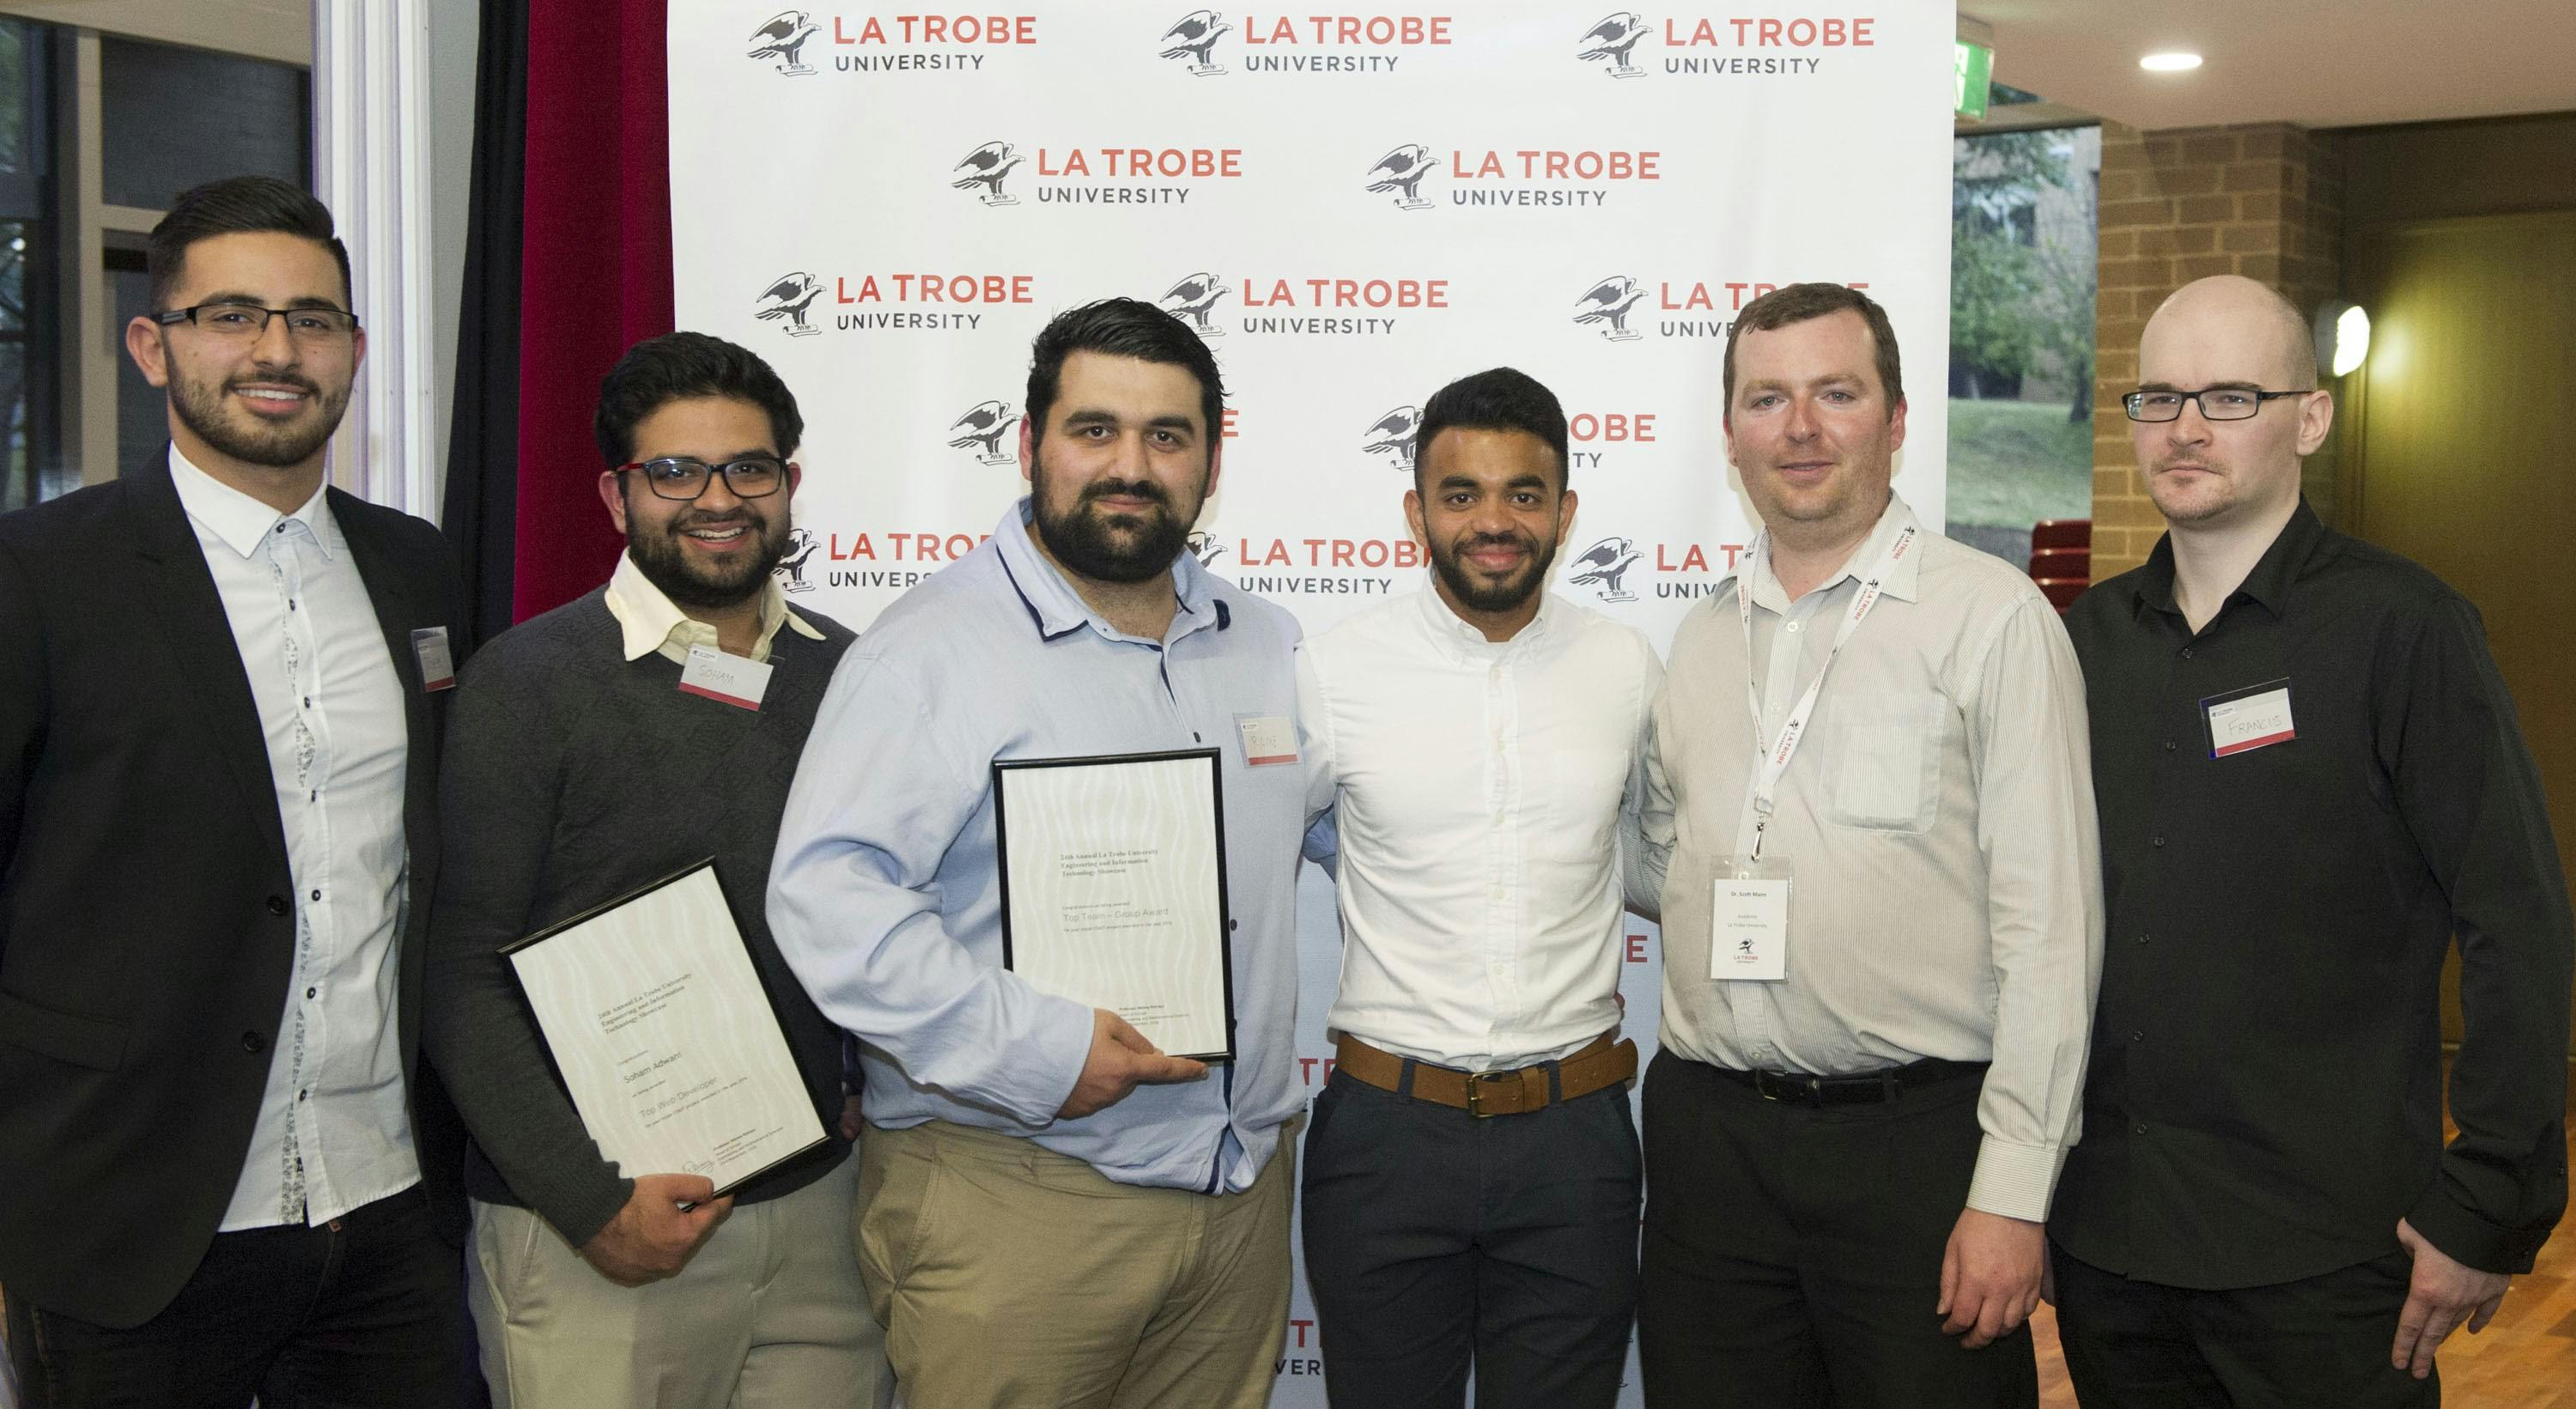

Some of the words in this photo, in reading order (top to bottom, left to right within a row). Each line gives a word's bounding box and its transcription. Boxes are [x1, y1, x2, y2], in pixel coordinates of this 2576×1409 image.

[835, 16, 886, 45] LA
[897, 15, 1037, 45] TROBE
[1246, 15, 1297, 45] LA
[1309, 15, 1452, 46] TROBE
[1666, 18, 1717, 46] LA
[1729, 18, 1874, 47] TROBE
[835, 54, 984, 71] UNIVERSITY
[1246, 55, 1399, 72] UNIVERSITY
[1665, 58, 1820, 74] UNIVERSITY
[1038, 149, 1090, 177] LA
[1102, 149, 1242, 178] TROBE
[1453, 150, 1504, 179] LA
[1517, 150, 1661, 179] TROBE
[1038, 187, 1190, 203] UNIVERSITY
[1453, 190, 1607, 206] UNIVERSITY
[837, 275, 881, 304] LA
[892, 274, 1034, 303] TROBE
[1243, 278, 1295, 307] LA
[1307, 279, 1449, 307] TROBE
[1661, 282, 1714, 310] LA
[837, 313, 981, 331] UNIVERSITY
[1243, 318, 1395, 334] UNIVERSITY
[1570, 413, 1656, 442] OBE
[830, 533, 876, 561] LA
[887, 533, 994, 562] TRO
[1240, 538, 1291, 566] LA
[1657, 544, 1710, 572] LA
[829, 572, 931, 587] UNIVER
[1240, 576, 1392, 594] UNIVERSITY
[2228, 715, 2282, 736] FRANCIS
[1063, 914, 1079, 923] Top
[1081, 912, 1105, 921] Team
[1115, 910, 1140, 920] Group
[1142, 907, 1169, 916] Award
[650, 986, 685, 1004] Information
[661, 974, 692, 989] University
[623, 1066, 652, 1084] Soham
[653, 1051, 682, 1071] Adwani
[639, 1107, 656, 1119] Top
[657, 1097, 677, 1110] Web
[677, 1077, 718, 1101] Developer
